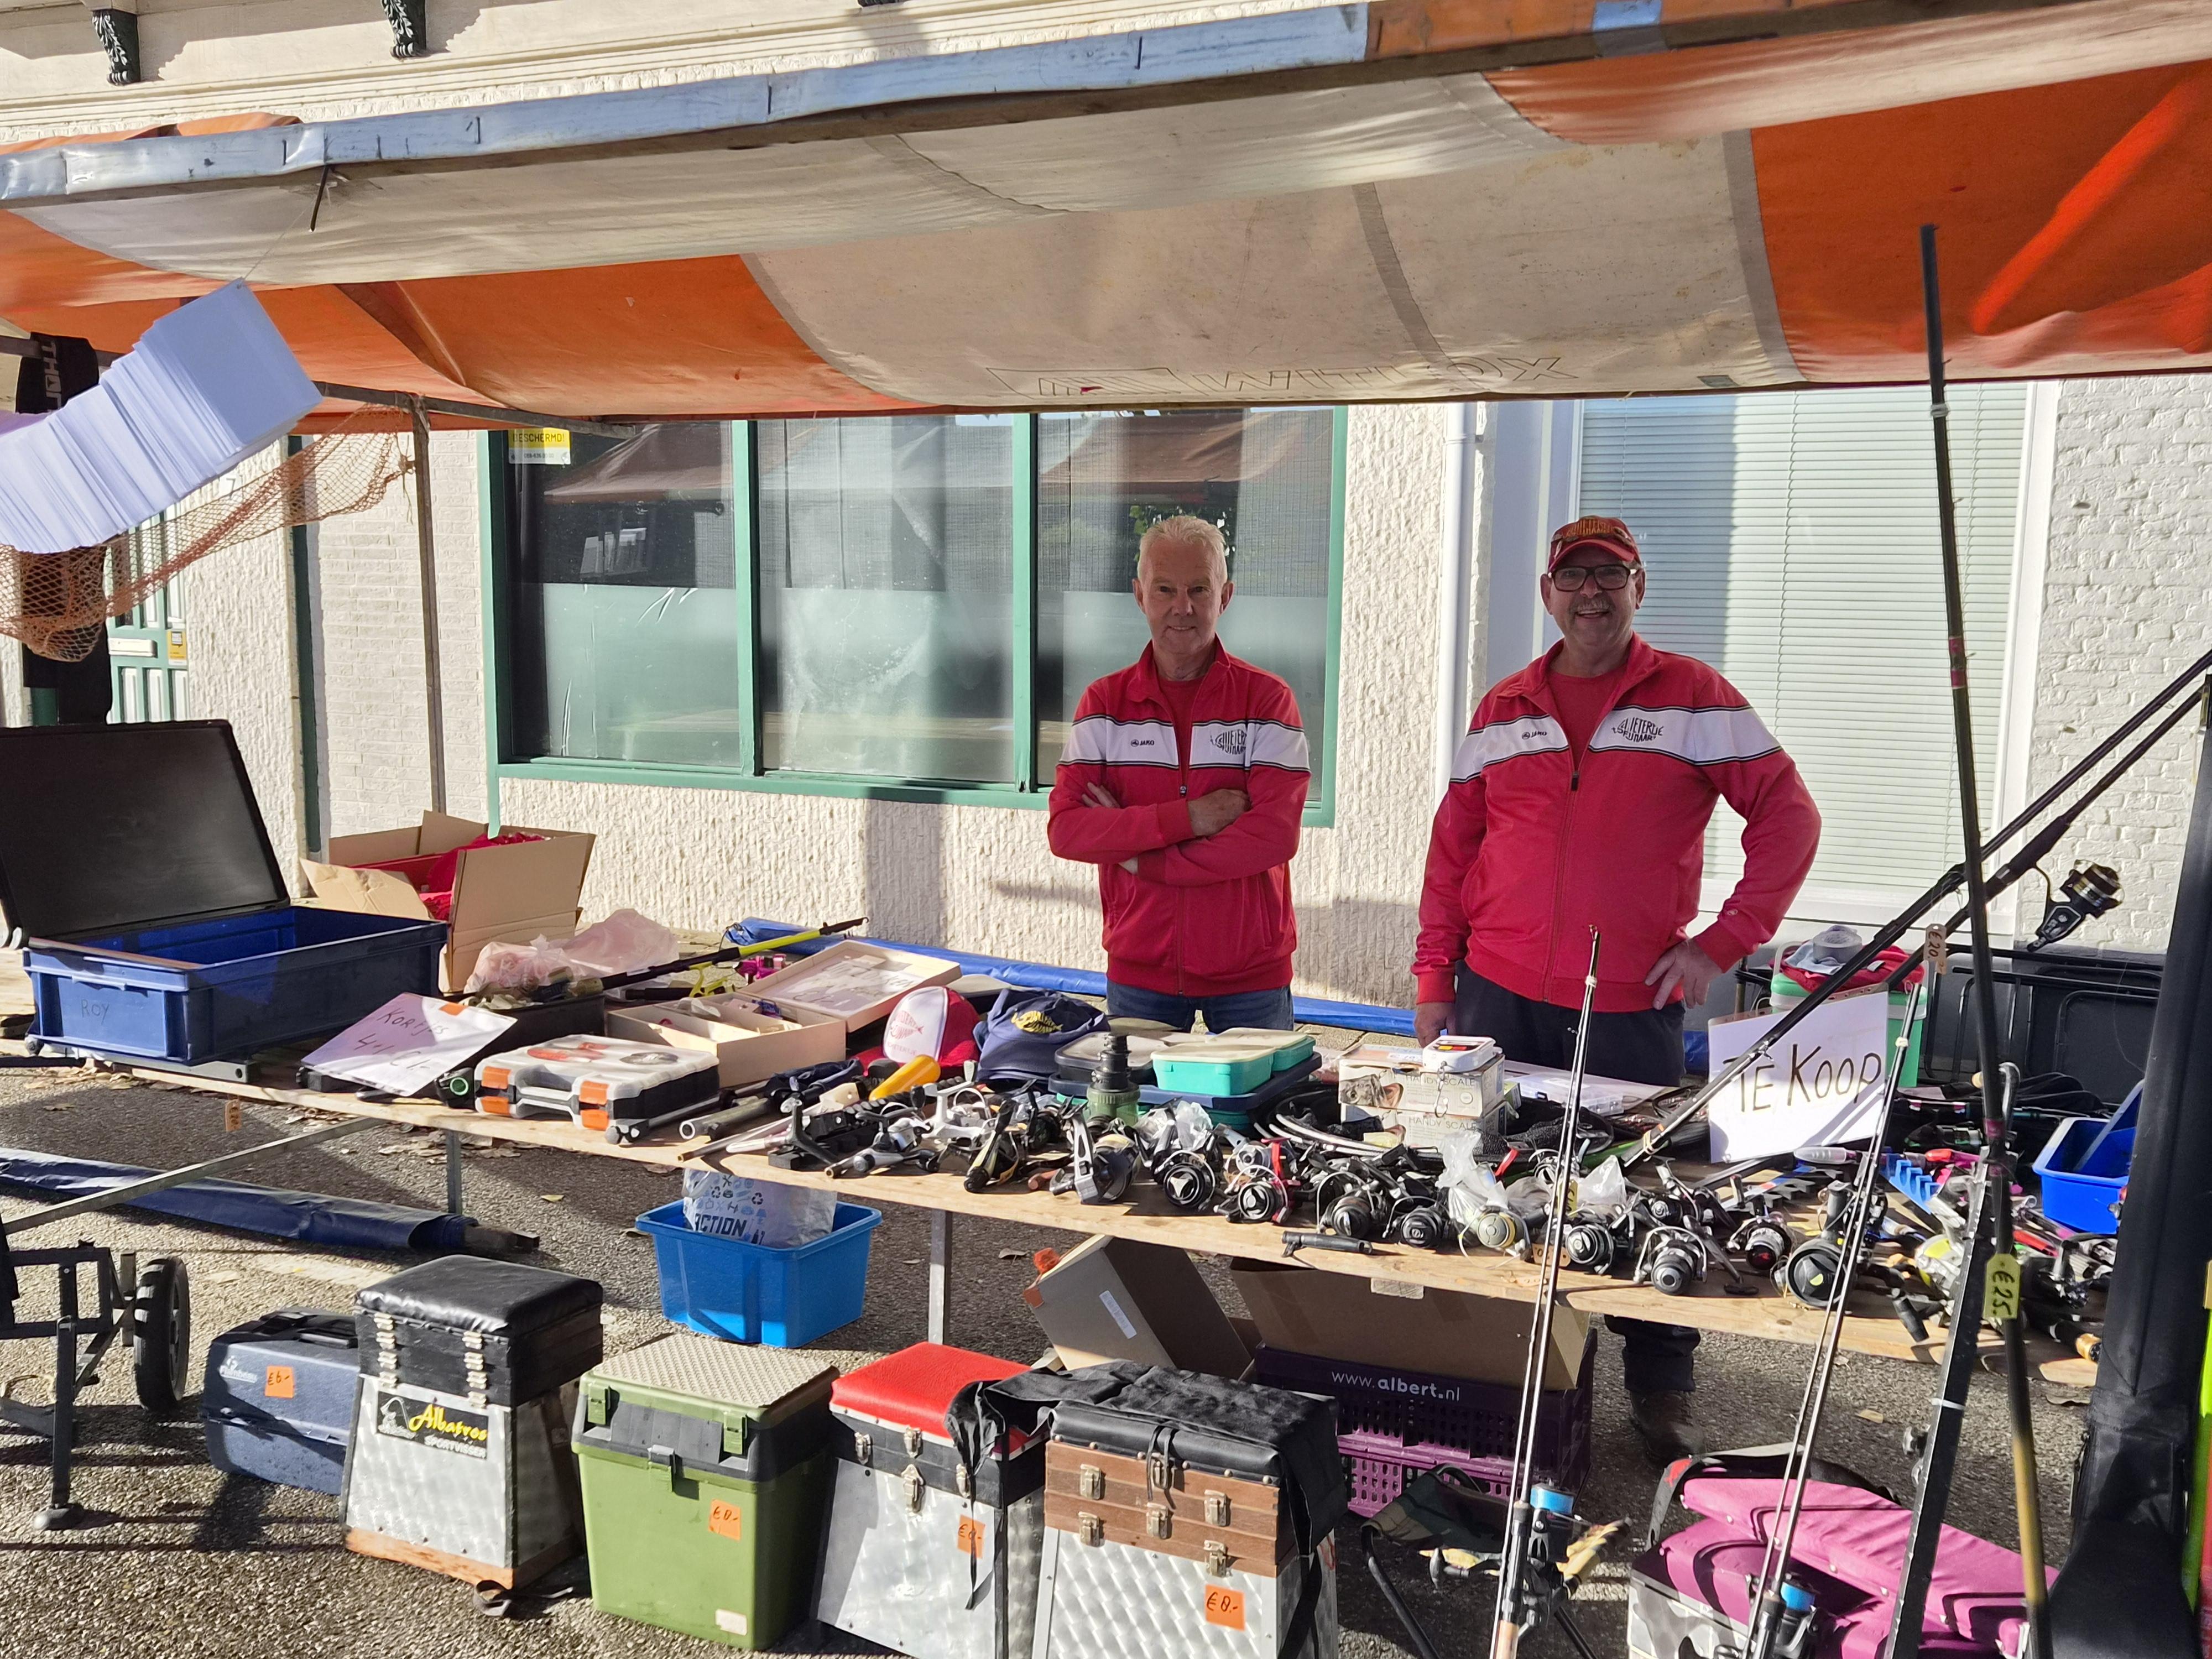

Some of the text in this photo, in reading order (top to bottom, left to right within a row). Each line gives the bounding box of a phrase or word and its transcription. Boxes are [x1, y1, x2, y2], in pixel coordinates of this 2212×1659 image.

[81, 999, 110, 1026] ROY
[1723, 1044, 1882, 1113] TE KOOP
[1408, 1117, 1442, 1128] HANDY
[694, 1212, 747, 1237] ACTION
[1332, 1371, 1460, 1401] www.albert.nl
[408, 1404, 488, 1441] Albatros
[424, 1434, 487, 1459] SPORTVISSER
